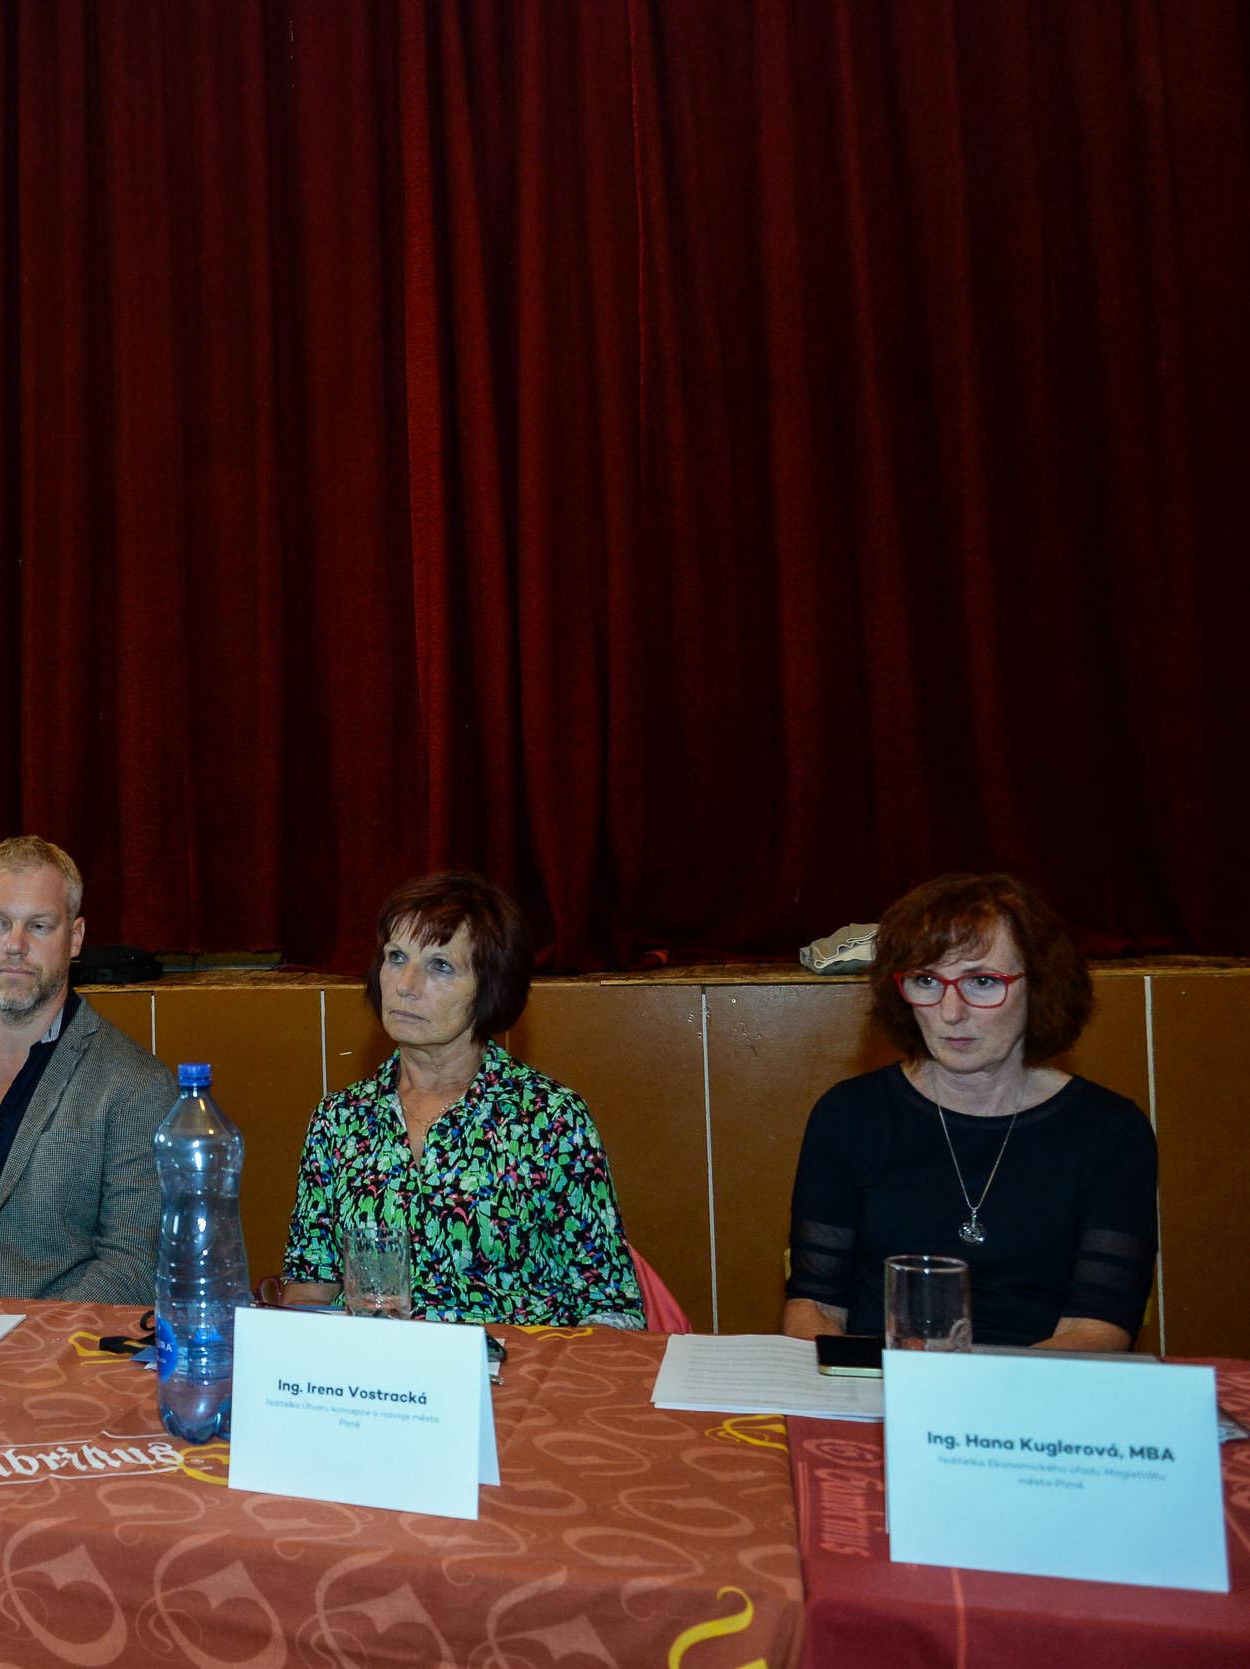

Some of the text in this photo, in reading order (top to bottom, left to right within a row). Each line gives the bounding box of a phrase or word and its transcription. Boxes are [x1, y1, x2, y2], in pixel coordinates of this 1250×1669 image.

[278, 1379, 428, 1406] Ing. Irena Vostracká
[331, 1406, 371, 1418] koncepce
[380, 1410, 410, 1422] rozvoje
[412, 1413, 440, 1424] města
[927, 1431, 1175, 1462] Ing. Hana Kuglerová, MBA
